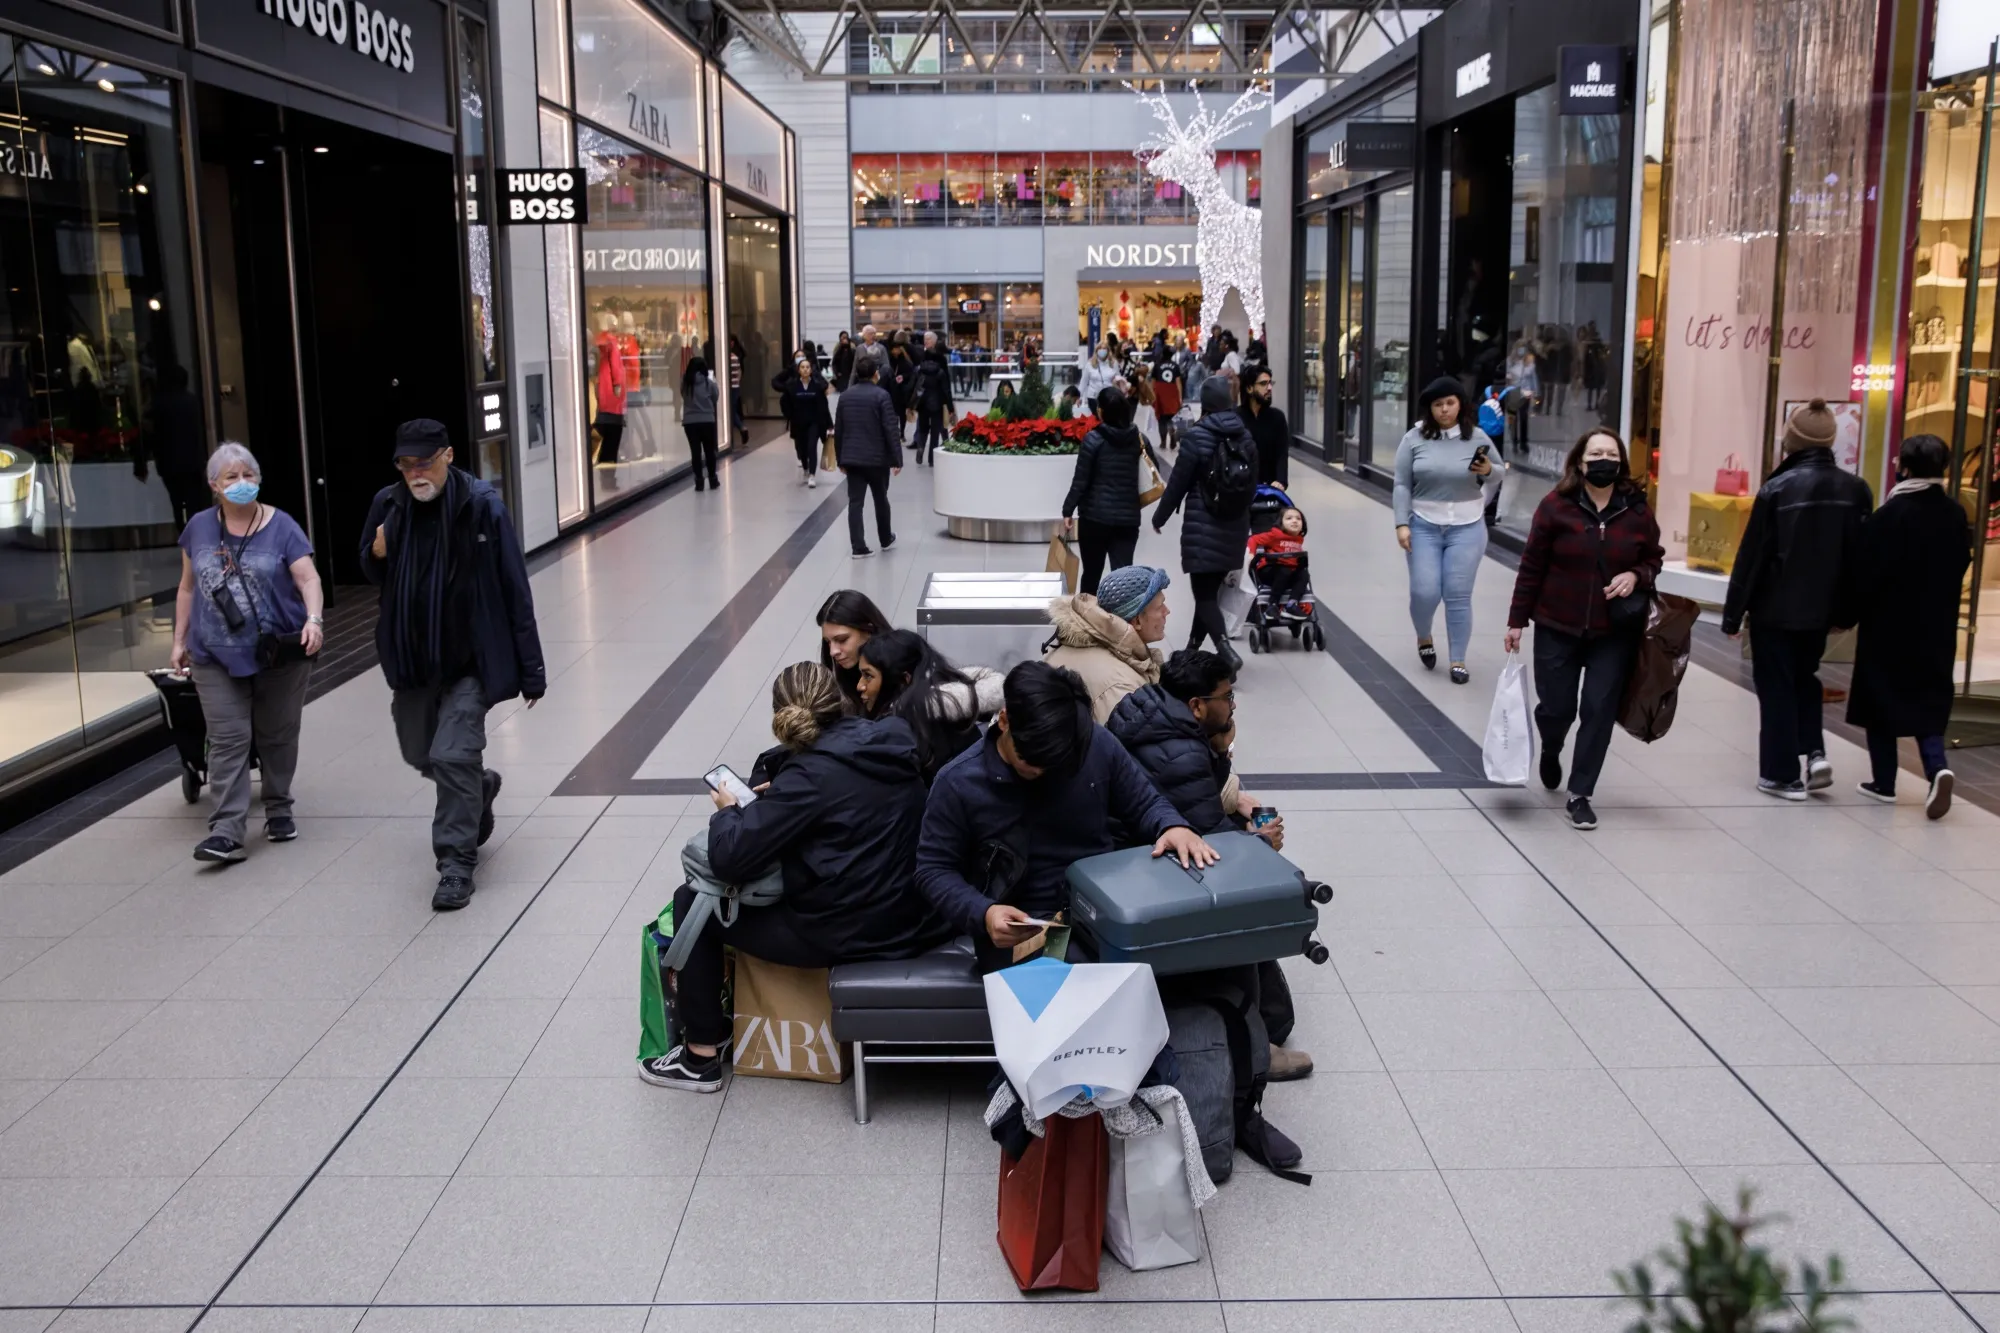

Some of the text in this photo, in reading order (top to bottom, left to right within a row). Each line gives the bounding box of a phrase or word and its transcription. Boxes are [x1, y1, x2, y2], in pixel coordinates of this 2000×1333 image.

[354, 1, 415, 74] BOSS
[1570, 83, 1616, 98] MACKAGE
[627, 92, 671, 148] ZARA
[508, 172, 574, 192] HUGO
[746, 162, 769, 197] ZARA
[509, 197, 575, 220] BOSS
[1684, 314, 1816, 353] let's dace
[733, 1013, 841, 1075] ZARA
[1053, 1046, 1127, 1062] BENTLEY
